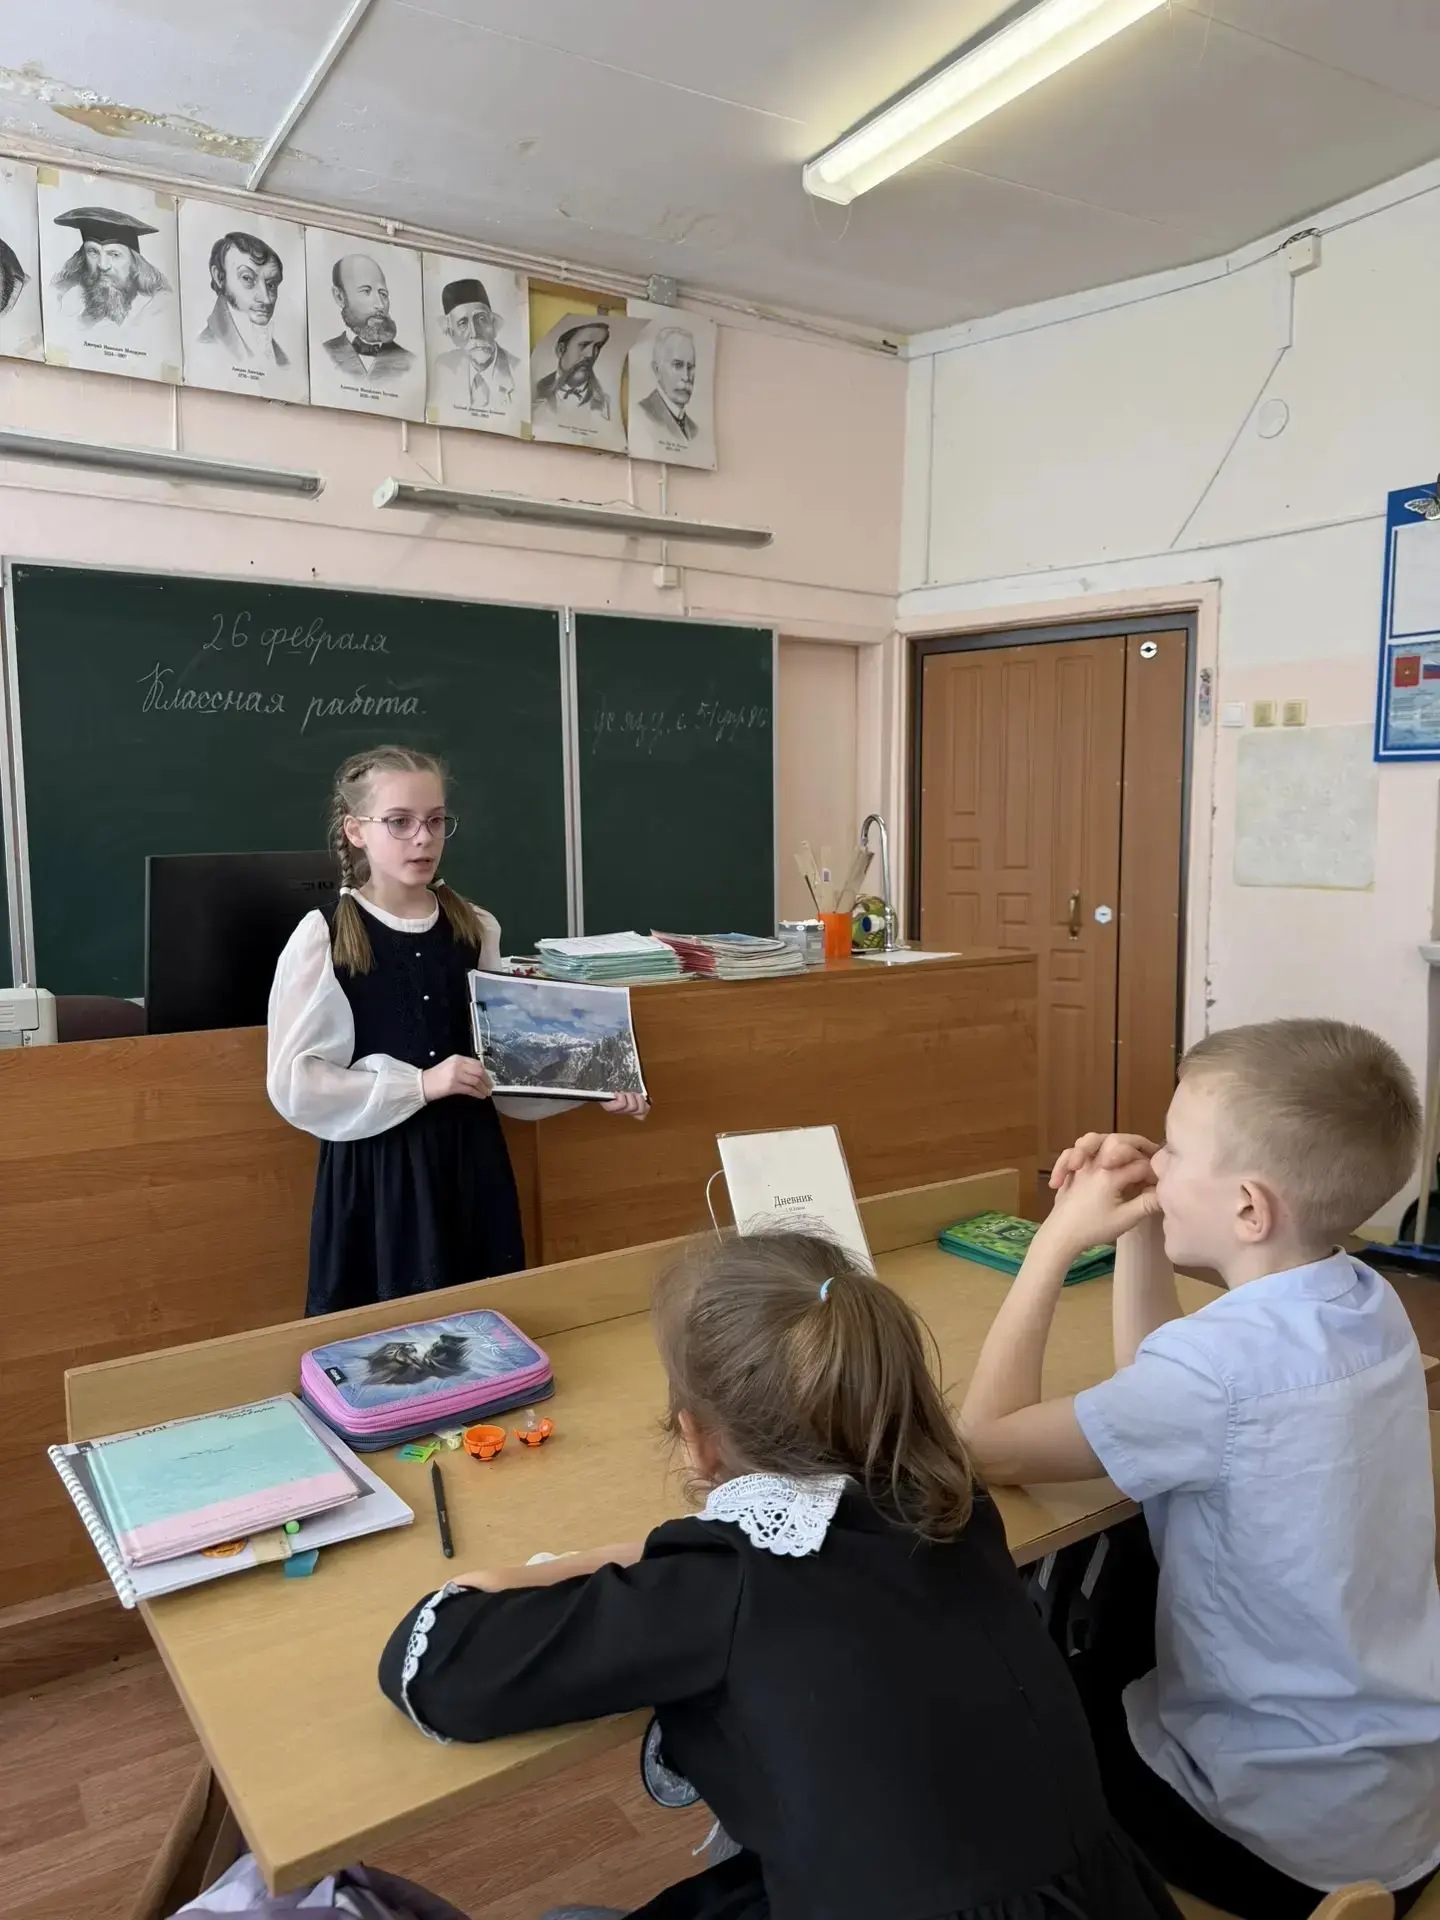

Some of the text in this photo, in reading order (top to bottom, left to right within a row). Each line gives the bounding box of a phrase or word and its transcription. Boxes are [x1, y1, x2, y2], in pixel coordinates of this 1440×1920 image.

[203, 611, 390, 666] 26 февраля
[136, 662, 286, 713] Классная
[773, 1195, 813, 1208] Дневник
